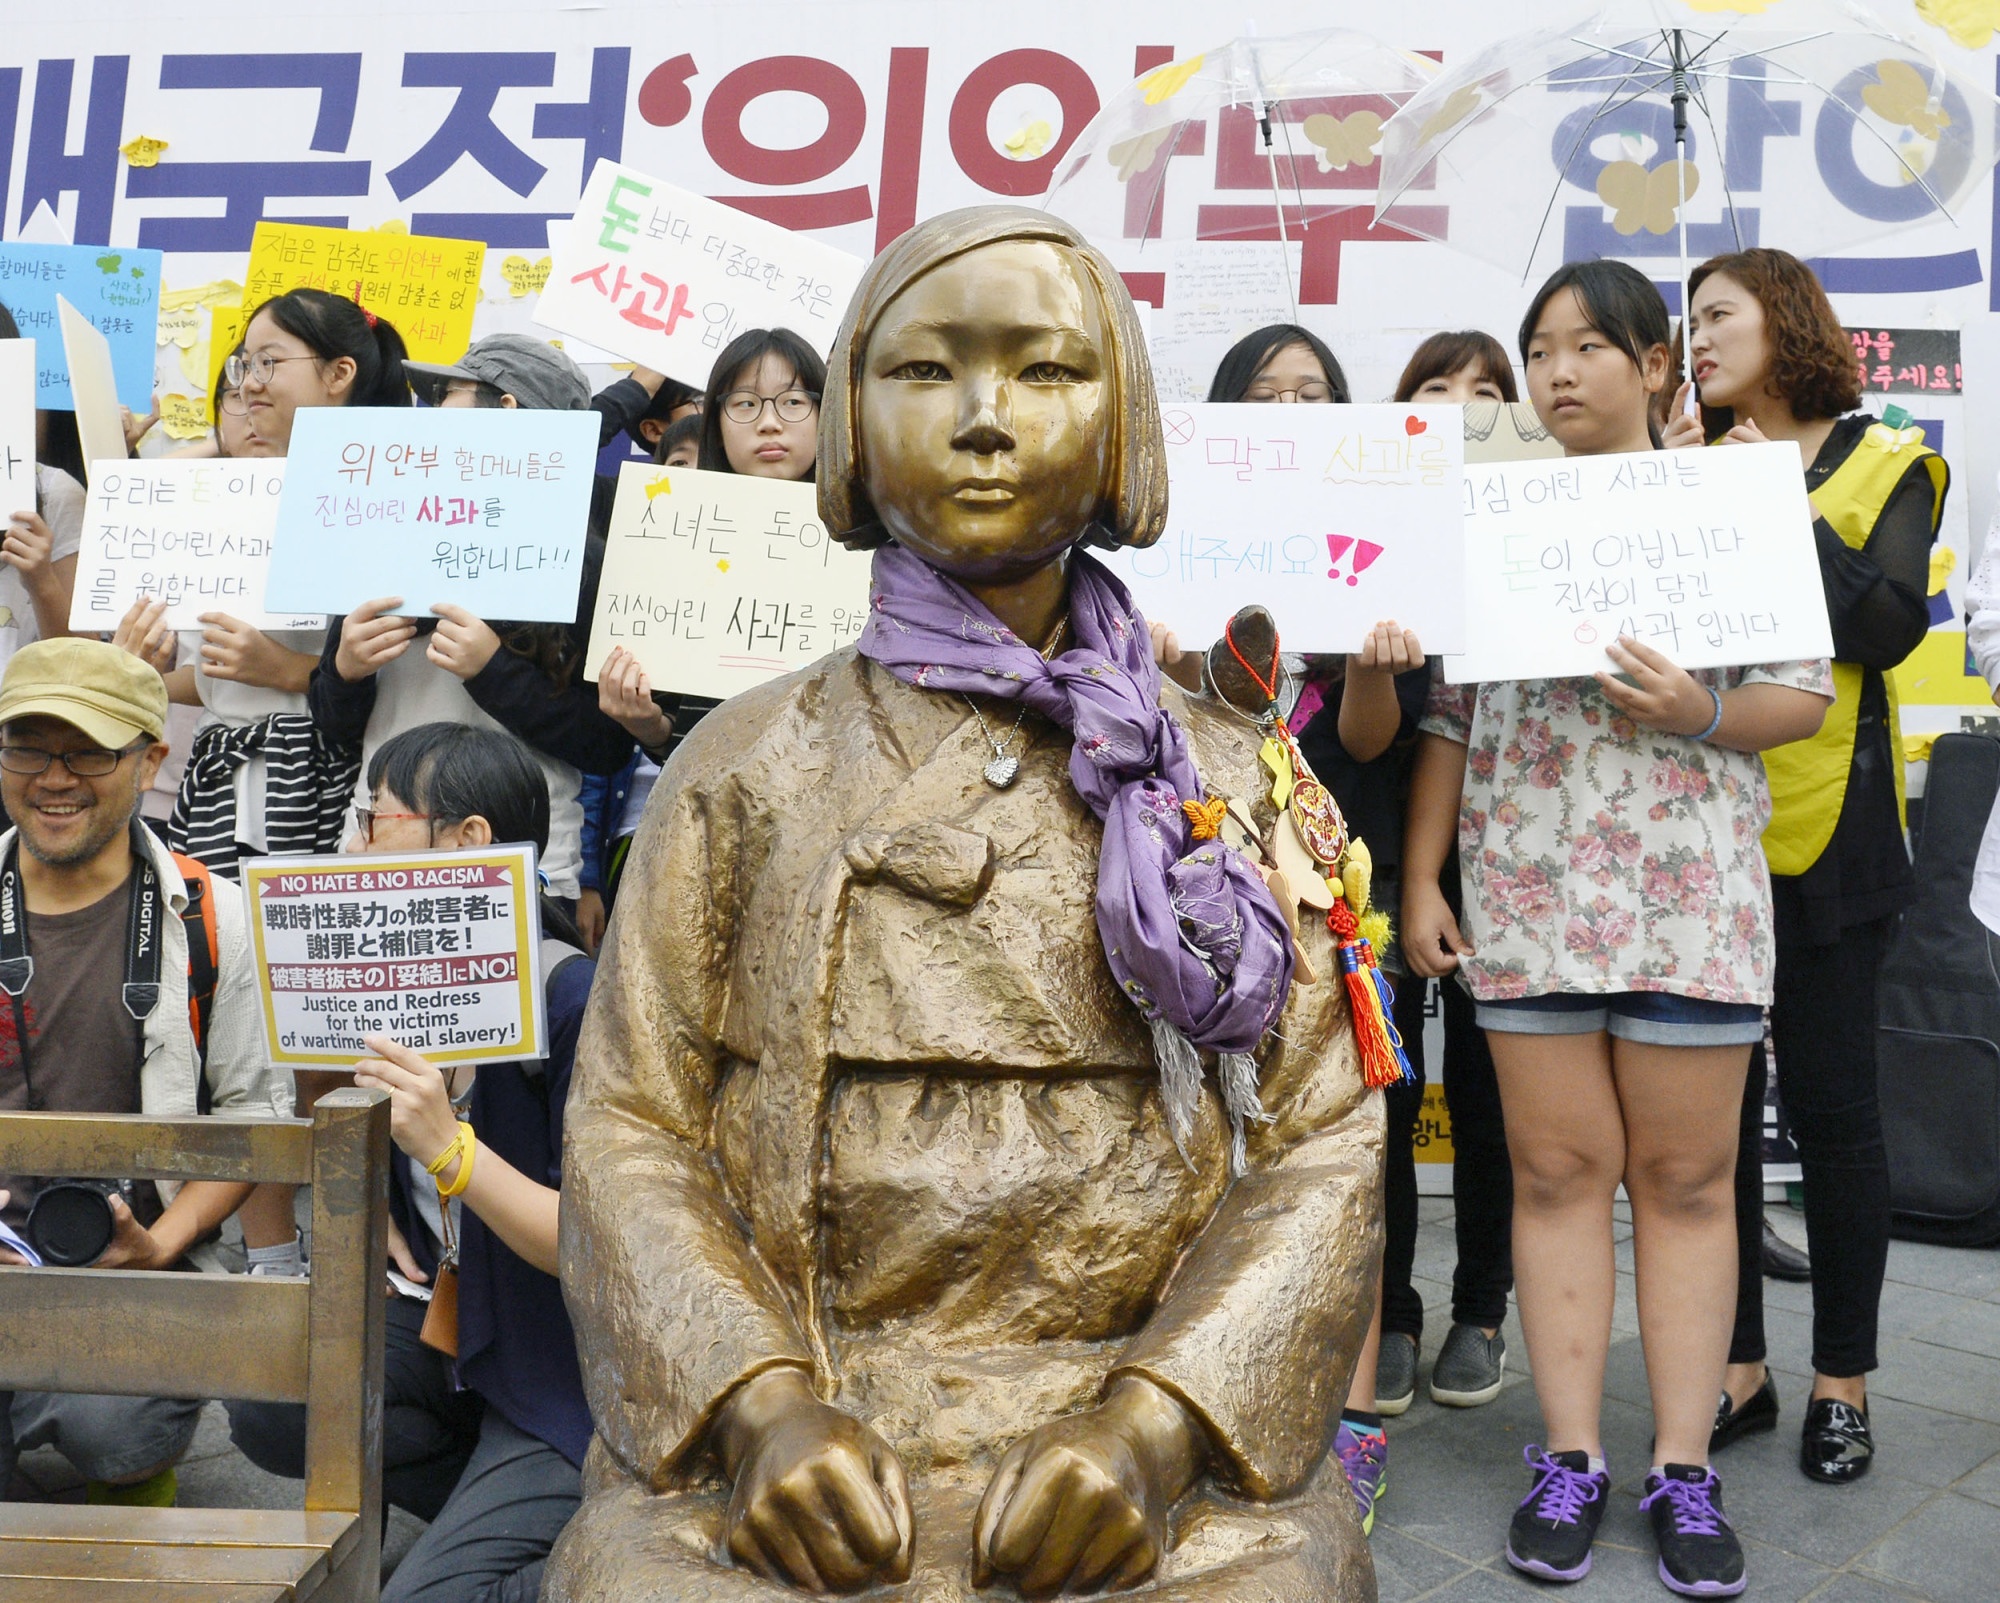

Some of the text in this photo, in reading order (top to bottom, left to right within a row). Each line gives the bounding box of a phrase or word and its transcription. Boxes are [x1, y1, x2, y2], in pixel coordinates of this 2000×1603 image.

[260, 232, 317, 266] 지금은
[325, 240, 379, 275] 감춰도
[249, 268, 285, 297] 슬픈
[790, 275, 832, 319] 것은
[8, 307, 56, 329] 습니다.
[406, 318, 447, 345] 사과
[338, 442, 566, 486] 위안부 할머니들은
[1206, 436, 1300, 481] 말고
[1608, 456, 1701, 493] 사과는
[98, 474, 177, 512] 우리는
[314, 494, 506, 529] 진심어린 사과를
[624, 500, 737, 555] 소녀는
[431, 541, 571, 579] 원합니다!!
[1592, 526, 1745, 569] 아닙니다
[1554, 571, 1713, 613] 진심이 담긴
[607, 593, 706, 640] 진심어린
[726, 597, 817, 652] 사과를
[1697, 610, 1780, 648] 입니다
[280, 866, 485, 894] NO HATE & NO RACISM
[2, 870, 16, 935] Canon
[265, 894, 509, 931] 戦時性暴力の被害者に
[138, 891, 154, 958] DIGITAL
[302, 989, 482, 1013] Justice and Redress
[281, 1031, 296, 1048] of
[300, 1033, 366, 1050] wartime
[438, 1022, 516, 1046] slavery!
[326, 1010, 460, 1032] for the victims
